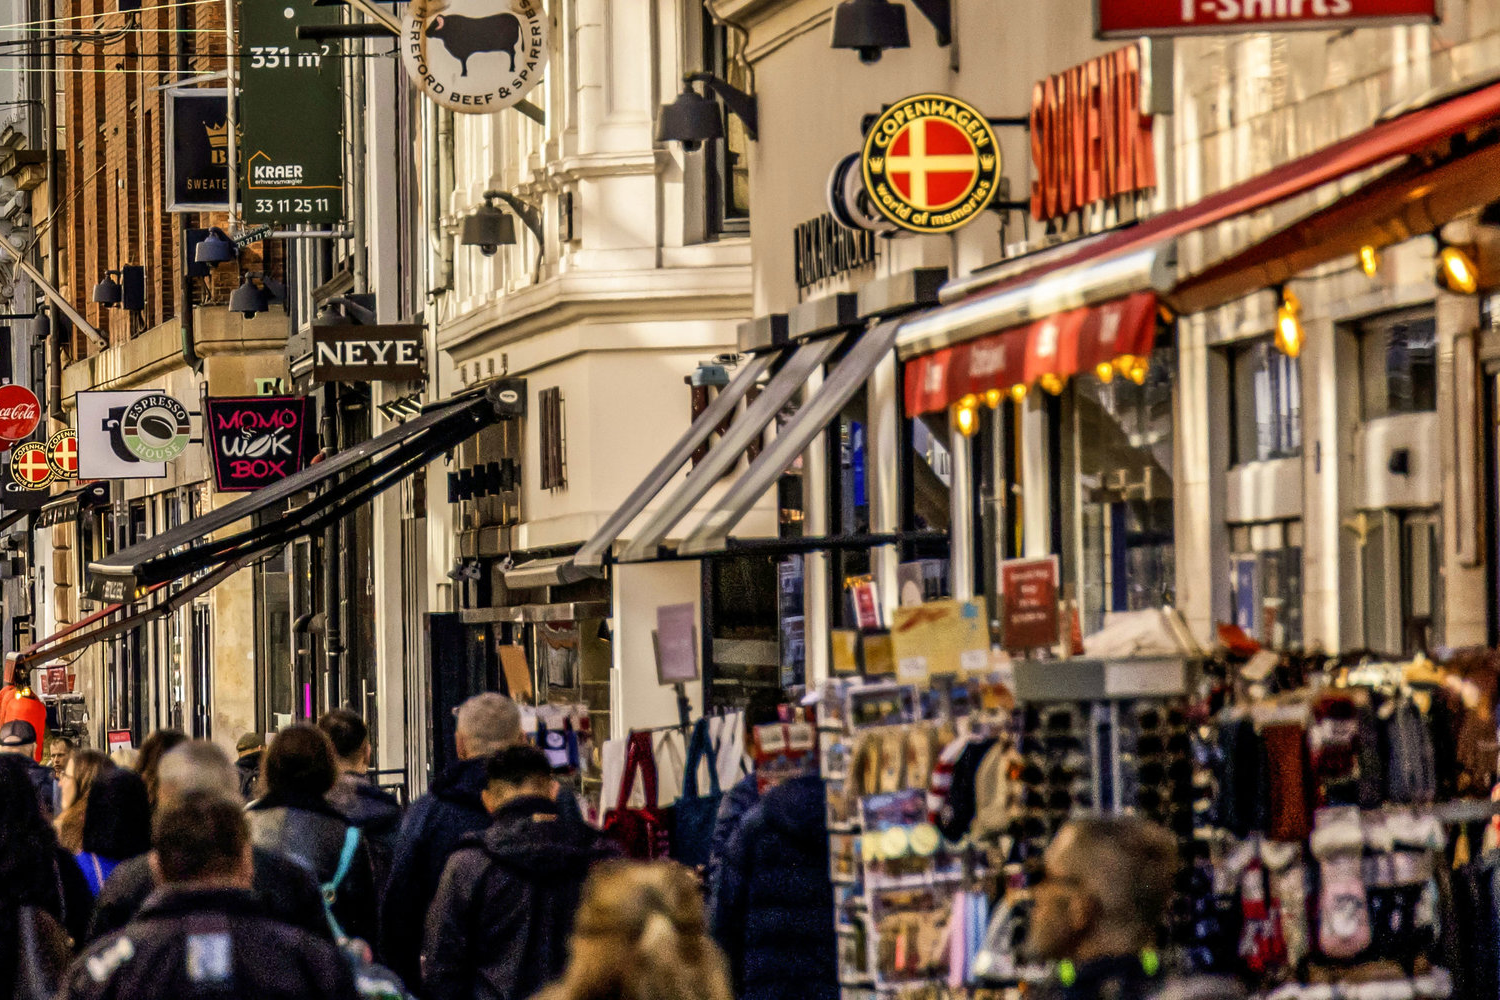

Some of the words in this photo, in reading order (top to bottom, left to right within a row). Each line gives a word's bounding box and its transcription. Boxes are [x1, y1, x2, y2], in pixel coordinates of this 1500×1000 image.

[250, 46, 291, 69] 331
[409, 5, 446, 95] HEREFORD
[449, 92, 494, 106] BEEF
[498, 87, 512, 99] &
[875, 100, 990, 149] COPENHAGEN
[254, 165, 303, 179] KRAER
[187, 178, 231, 190] SWEATE
[255, 199, 274, 213] 33
[277, 199, 290, 213] 11
[294, 199, 312, 213] 25
[315, 198, 329, 212] 11
[876, 182, 912, 220] world
[912, 211, 929, 225] of
[930, 180, 991, 226] memories
[316, 339, 419, 366] NEYE
[129, 396, 186, 420] ESPRESSO
[217, 408, 297, 430] MOMO
[49, 431, 77, 449] COPENH
[14, 444, 45, 461] COPENHA
[136, 442, 180, 460] HOUSE
[229, 459, 287, 479] BOX
